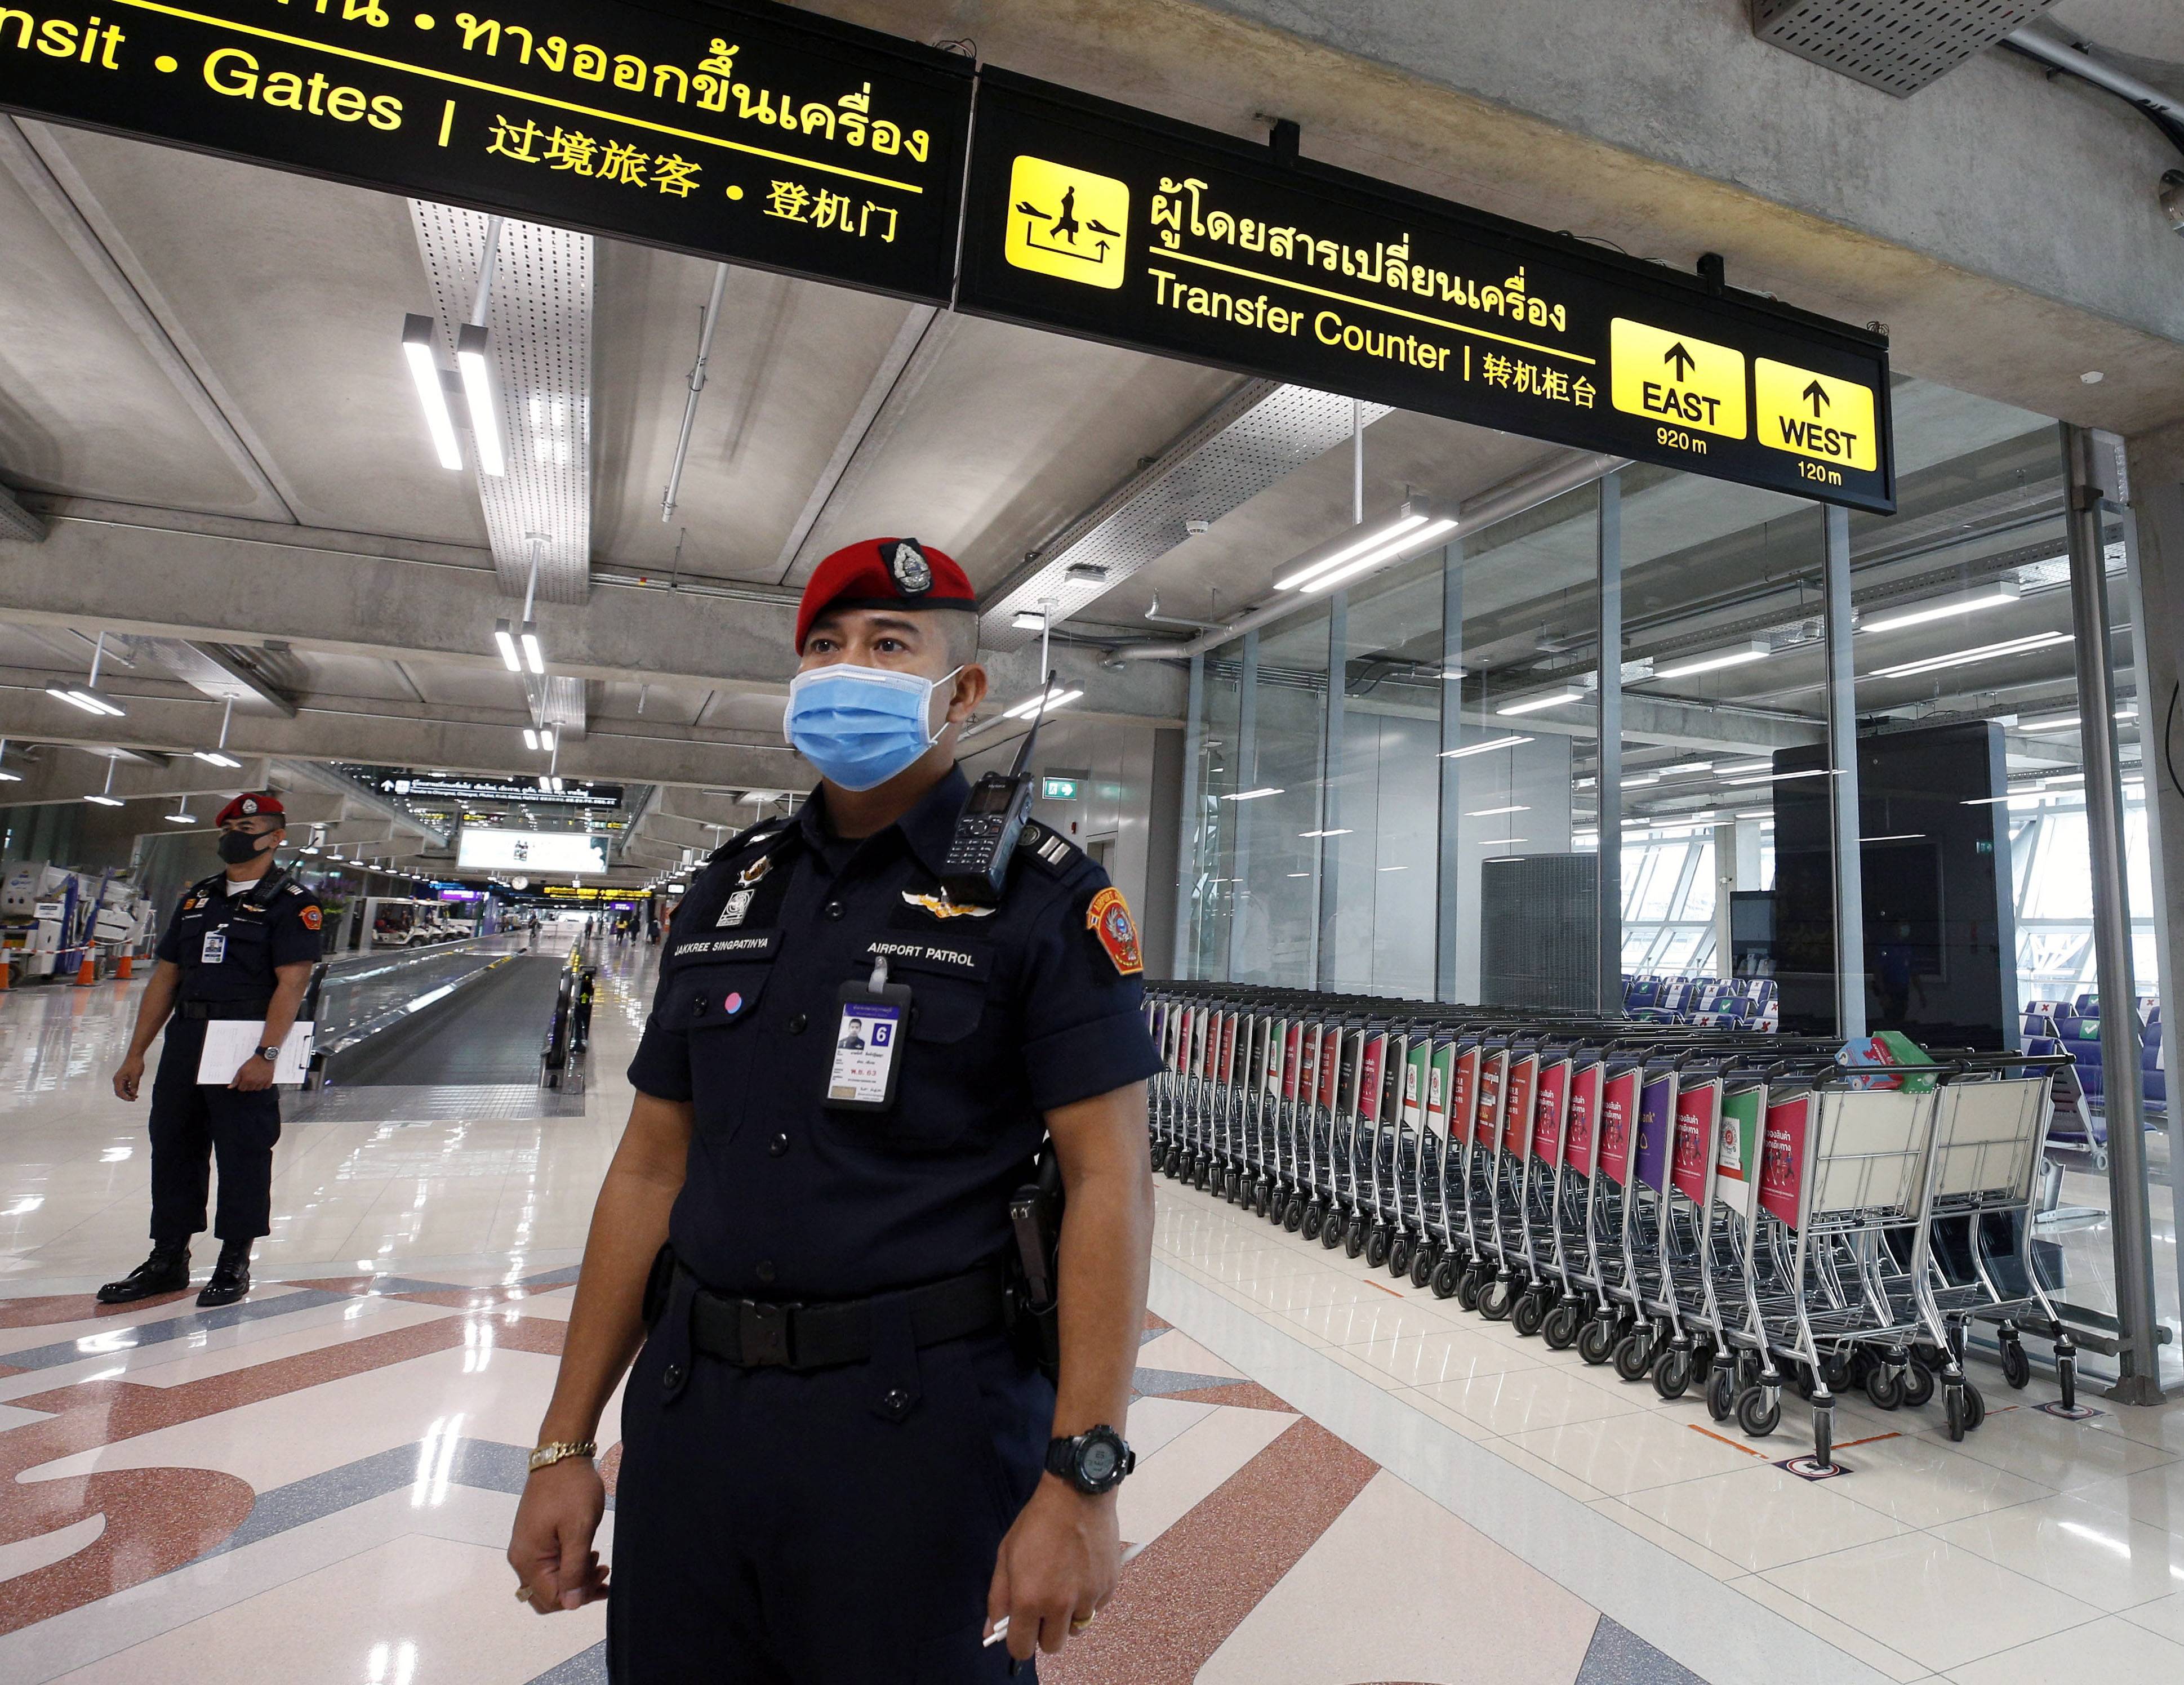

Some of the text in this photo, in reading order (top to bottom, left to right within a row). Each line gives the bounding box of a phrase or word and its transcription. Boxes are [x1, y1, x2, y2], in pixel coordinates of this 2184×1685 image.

[203, 48, 403, 131] Gates
[455, 12, 929, 163] ทางออกขึ้นเครื่อง
[486, 114, 898, 243] 过境旅客 登机门
[1149, 177, 1567, 332] ผู้โดยสารเปลี่ยนเครื่อง
[1147, 268, 1449, 370] Transfer Counter
[1483, 353, 1596, 409] 转机柜台
[1643, 381, 1721, 426] EAST
[1778, 415, 1857, 460] WEST
[674, 938, 768, 956] JAKKREE SINGPATINYA
[867, 942, 975, 967] AIRPORT PATROL
[876, 1026, 887, 1042] 6
